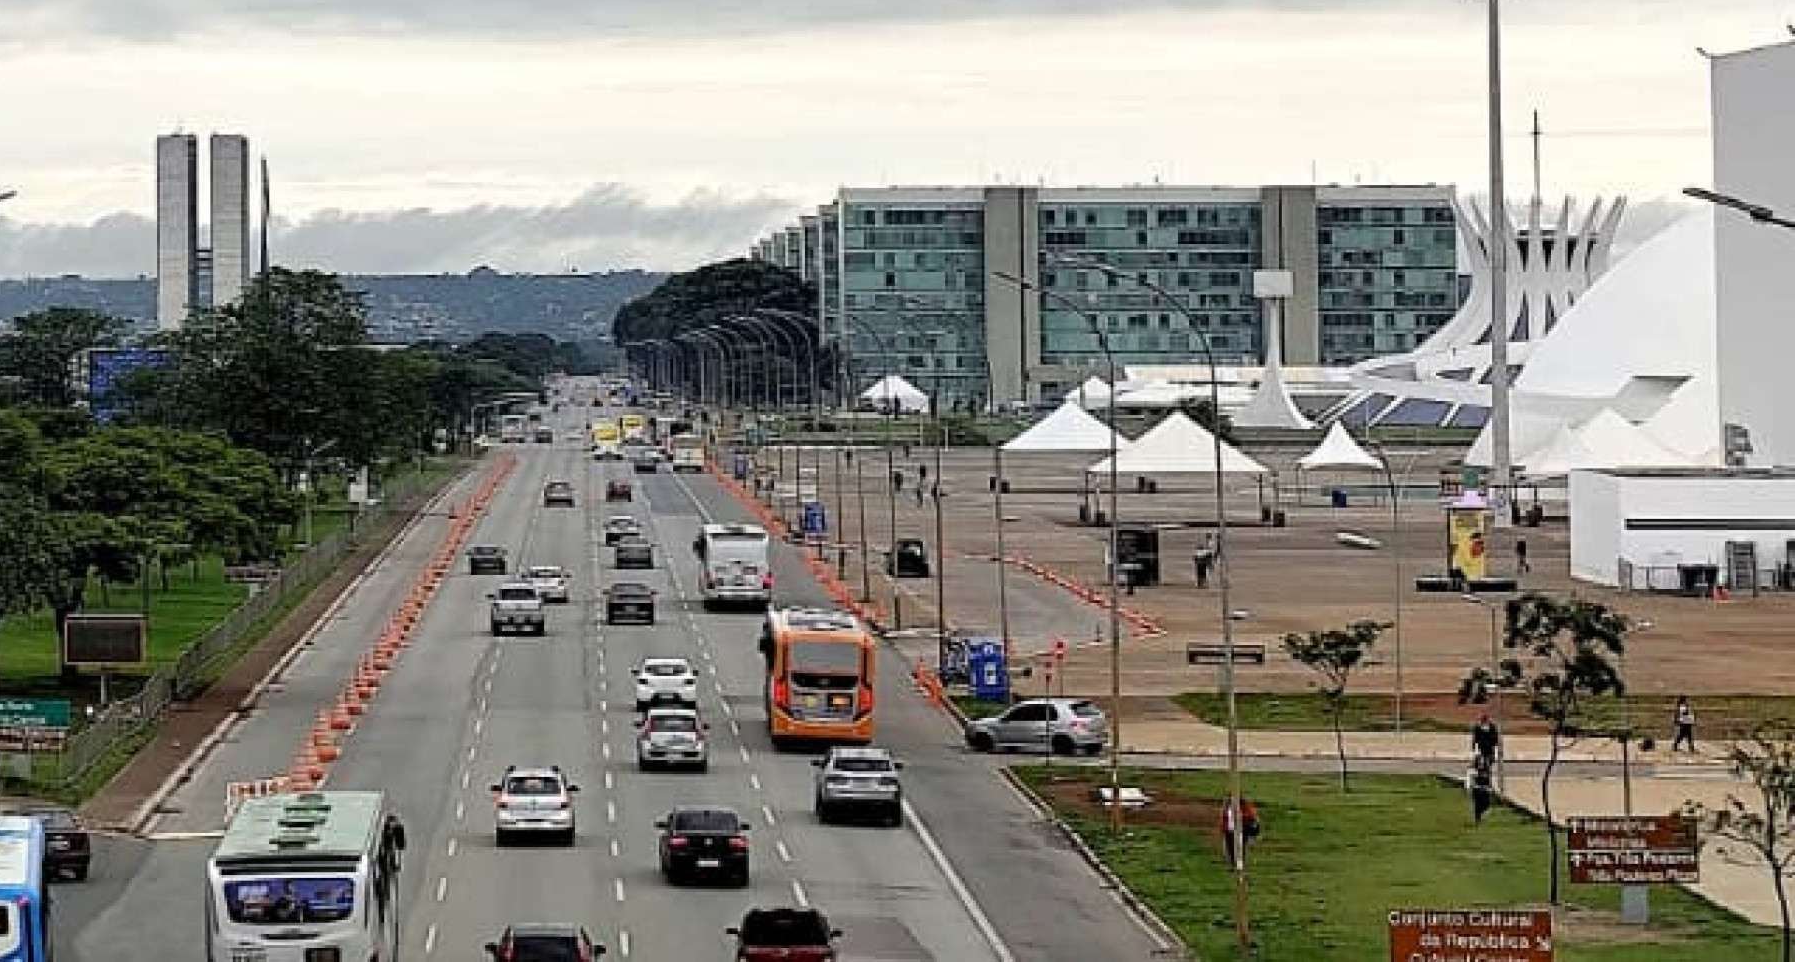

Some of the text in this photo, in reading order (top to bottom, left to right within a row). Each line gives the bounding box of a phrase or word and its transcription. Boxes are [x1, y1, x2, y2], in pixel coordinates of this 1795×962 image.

[1389, 909, 1534, 928] Conjunto Cultural
[1421, 932, 1529, 949] da República
